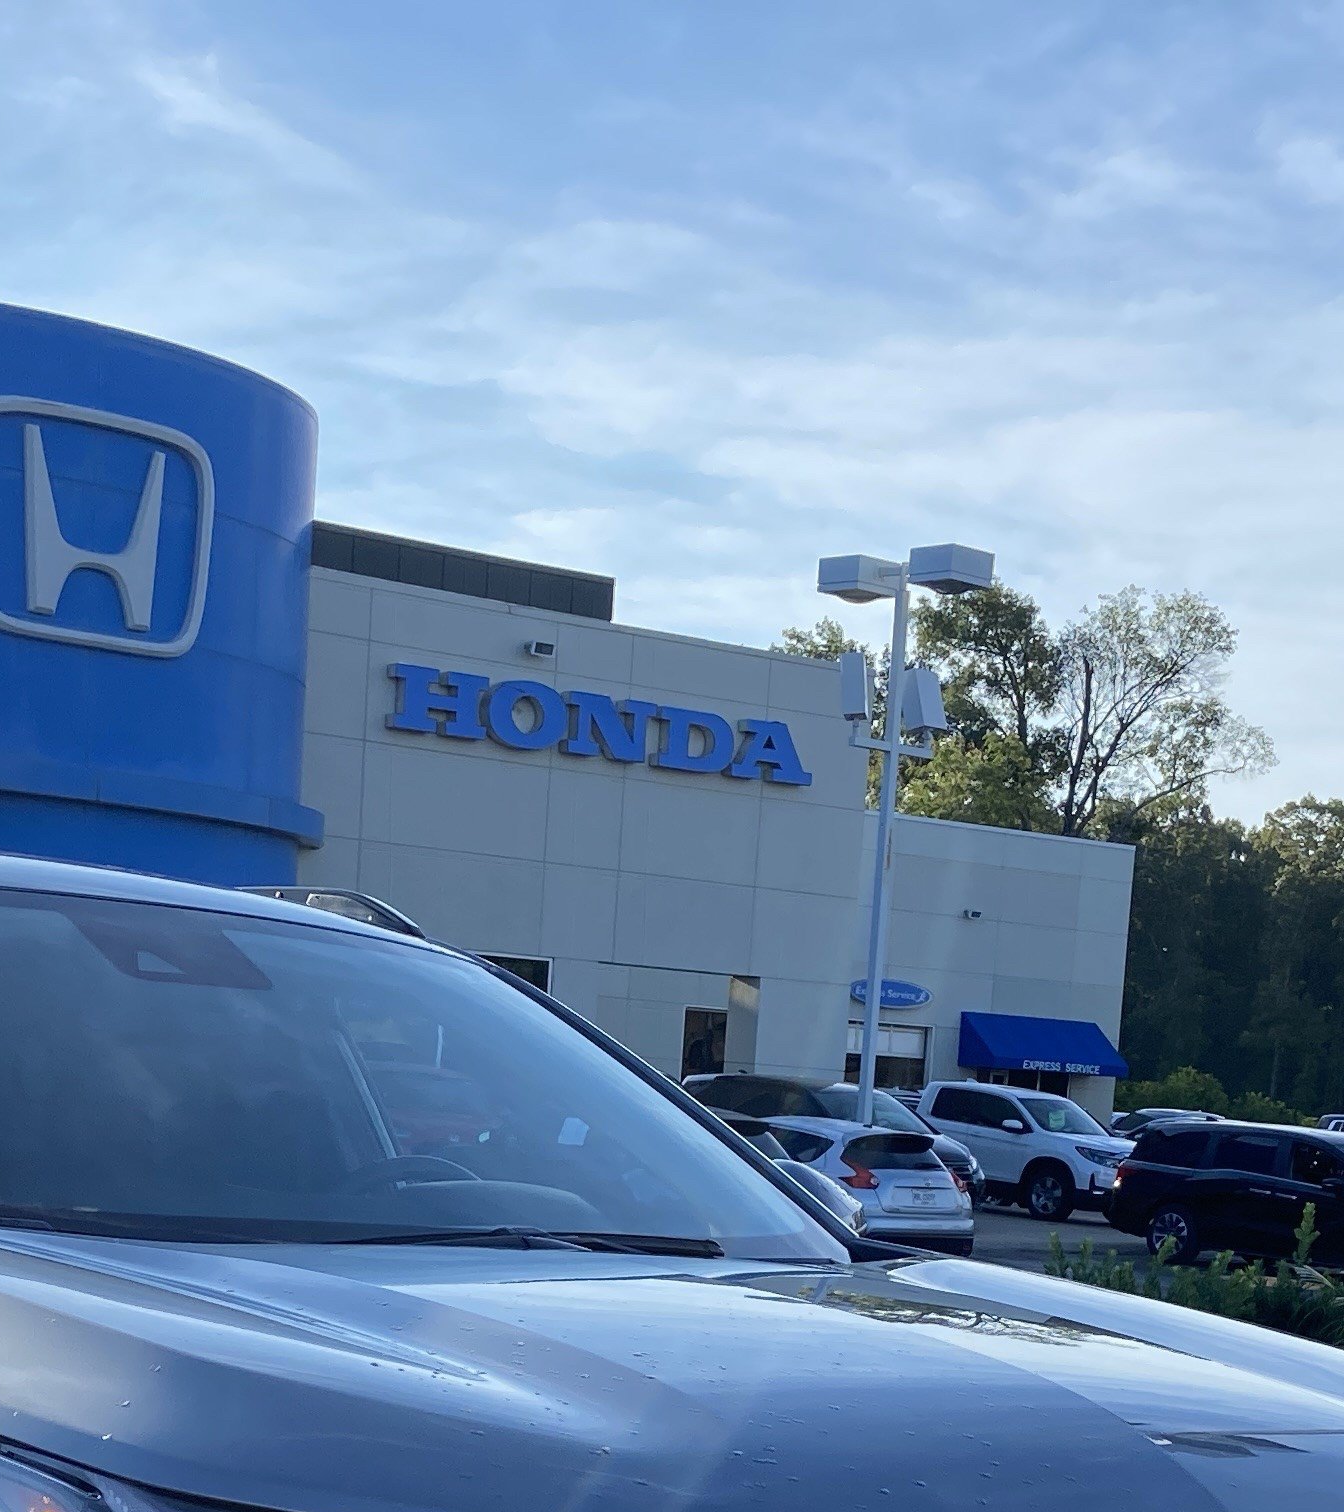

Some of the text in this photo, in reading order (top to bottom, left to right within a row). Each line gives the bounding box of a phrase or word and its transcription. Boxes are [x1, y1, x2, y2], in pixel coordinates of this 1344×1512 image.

[385, 662, 812, 786] HONDA
[887, 988, 916, 1000] Service
[1022, 1060, 1100, 1075] EXPRESS SERVICE
